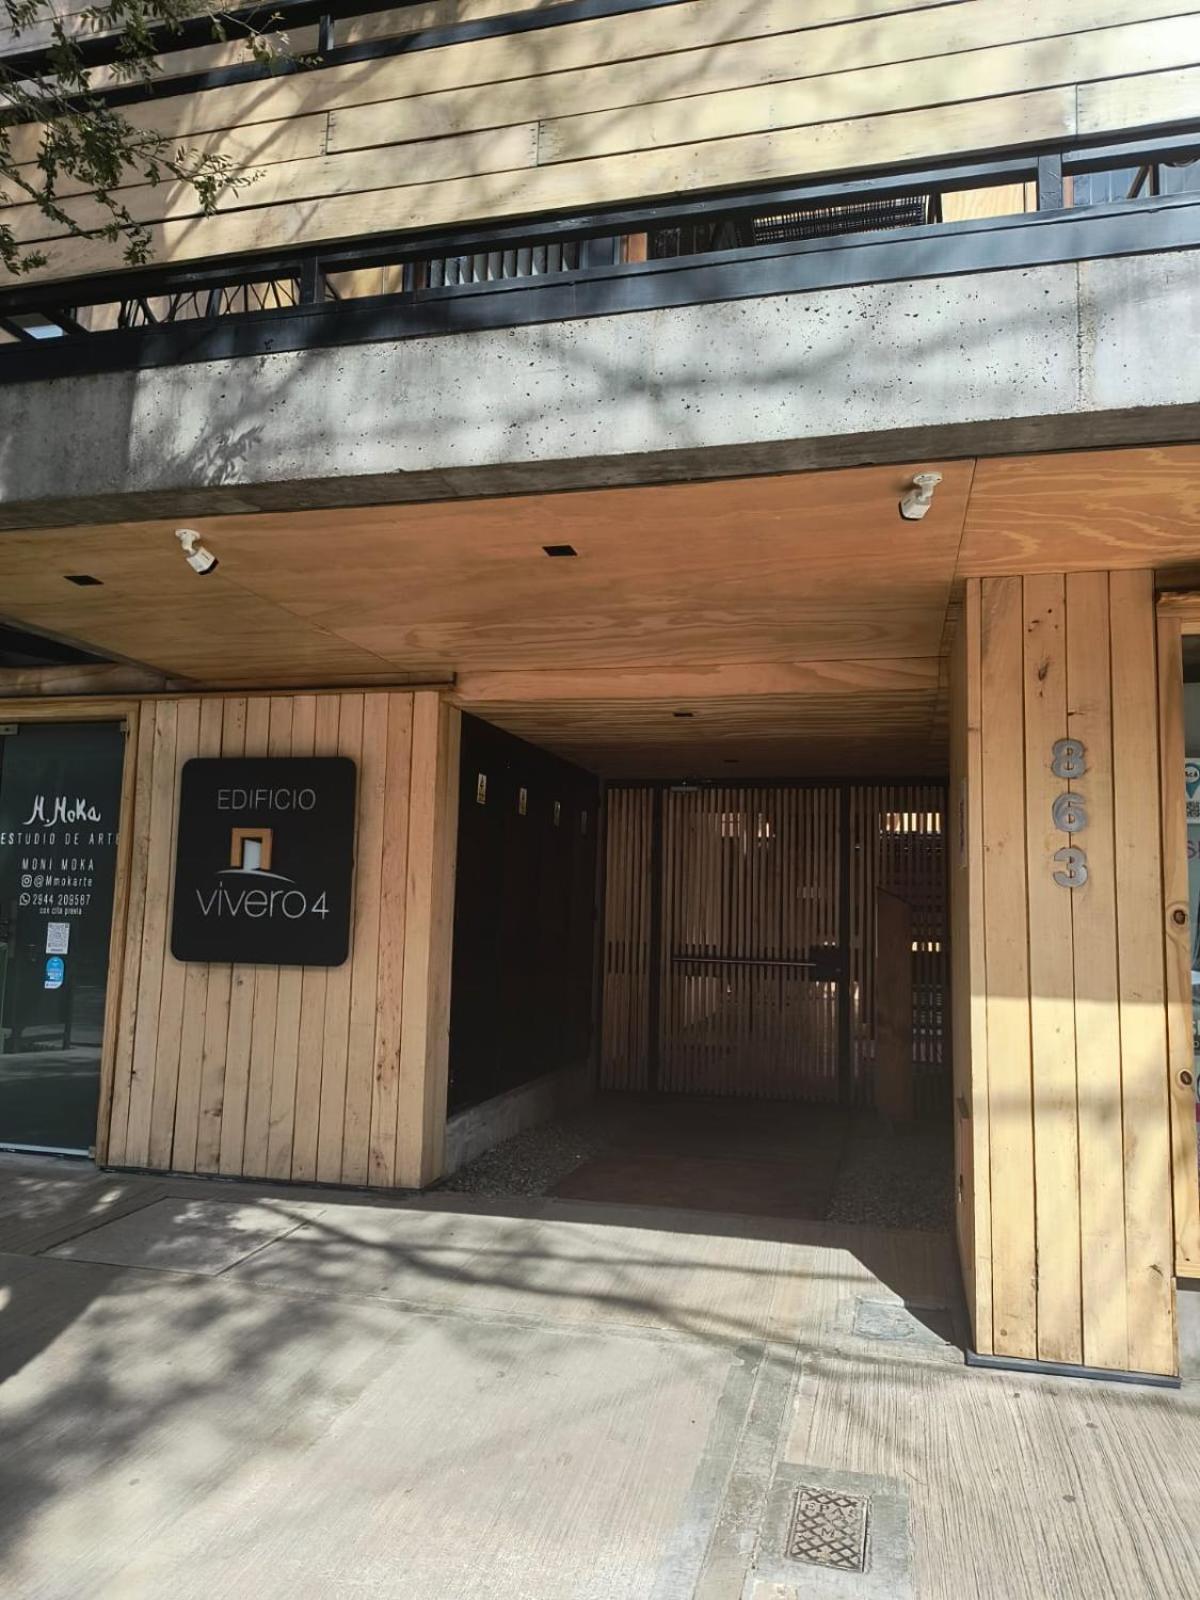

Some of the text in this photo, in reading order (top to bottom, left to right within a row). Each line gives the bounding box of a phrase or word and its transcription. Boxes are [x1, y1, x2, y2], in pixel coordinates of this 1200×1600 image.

[216, 788, 317, 810] EDIFICIO
[0, 833, 56, 845] ESTUDIO
[65, 833, 79, 845] DE
[22, 858, 94, 871] MONI MOKA
